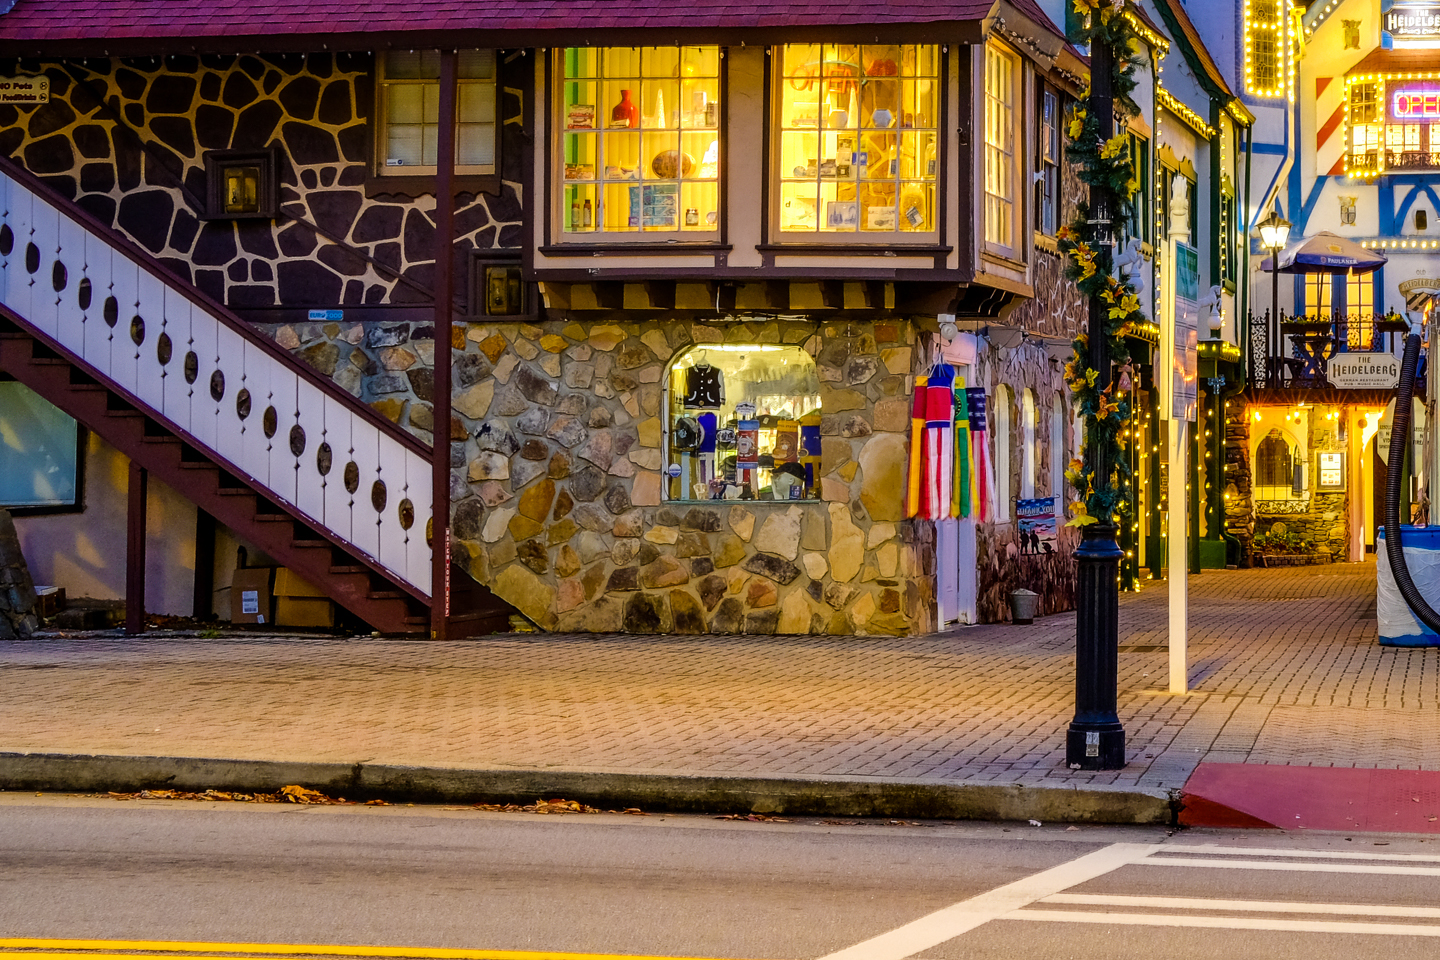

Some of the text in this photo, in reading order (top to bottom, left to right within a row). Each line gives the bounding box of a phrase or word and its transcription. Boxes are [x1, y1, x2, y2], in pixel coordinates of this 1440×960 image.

[1415, 9, 1430, 17] THE
[789, 65, 859, 94] OPEN
[1327, 257, 1359, 265] PAULANER
[1332, 363, 1397, 378] HEIDELBERG
[1018, 504, 1056, 516] THANK YOU
